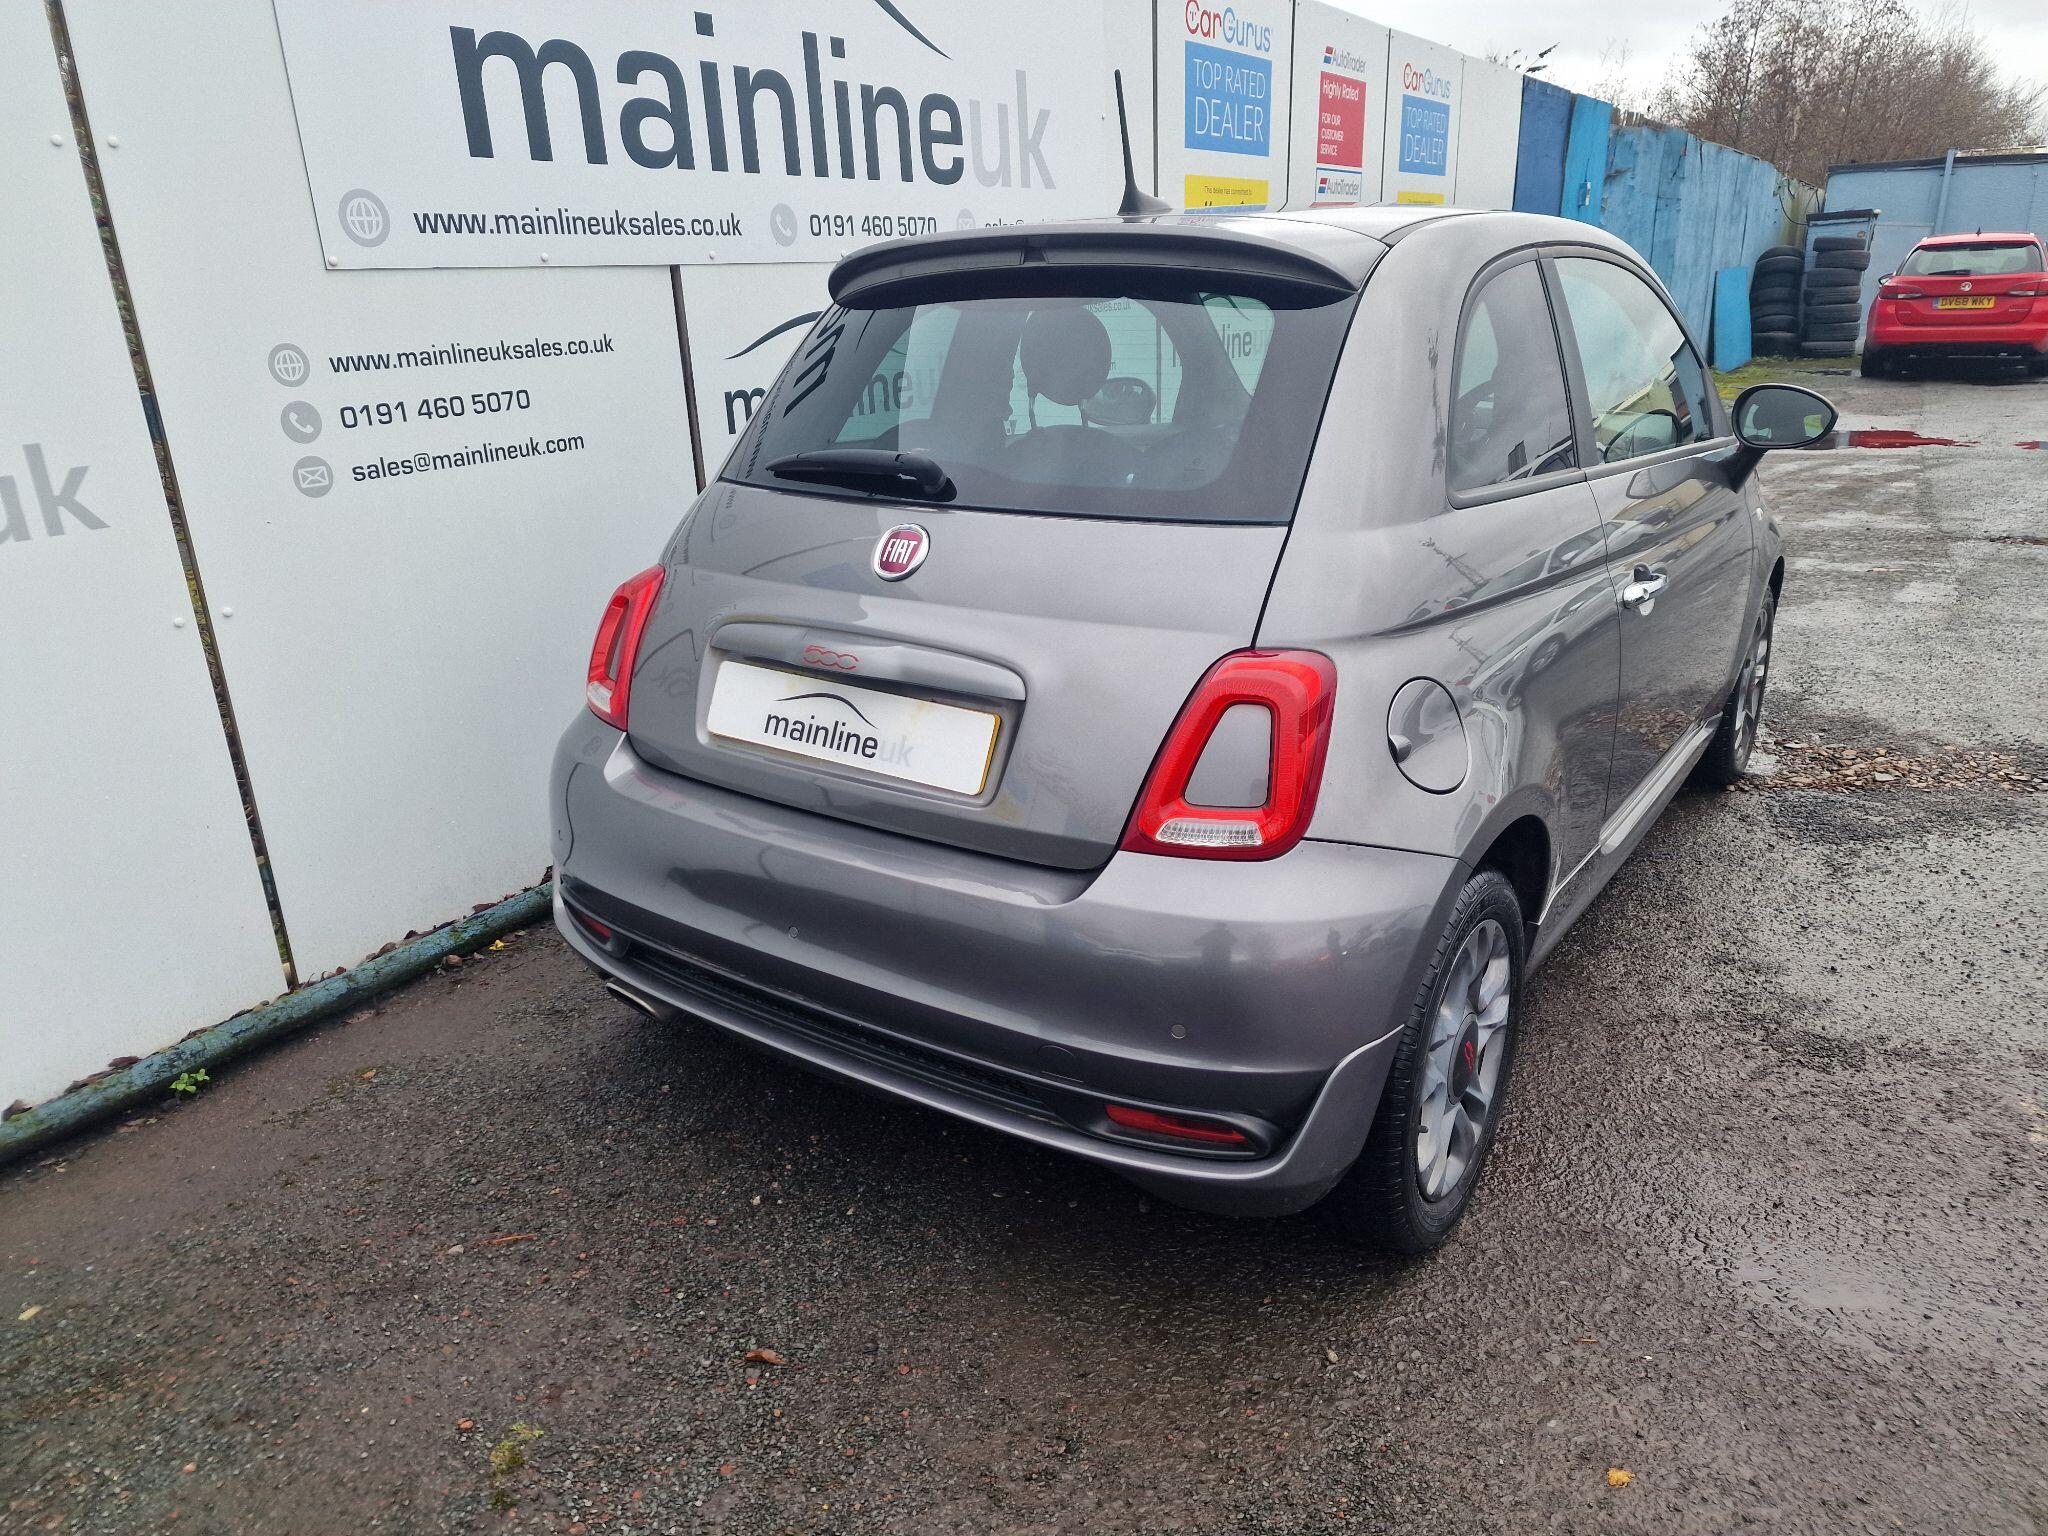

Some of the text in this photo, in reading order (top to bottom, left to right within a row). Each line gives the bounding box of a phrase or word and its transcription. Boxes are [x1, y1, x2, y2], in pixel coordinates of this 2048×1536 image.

[1186, 0, 1271, 52] CarGurus
[1194, 58, 1266, 99] TOP RATED
[1323, 79, 1359, 101] Highly Rated
[1403, 62, 1451, 99] CarGurus
[449, 10, 1057, 191] mainlineuk
[1195, 96, 1264, 142] DEALER
[1321, 112, 1342, 126] FOR OUR
[1407, 106, 1446, 134] TOP RATED
[1320, 143, 1338, 156] SERVICE
[1321, 129, 1344, 142] CUSTOMER
[1405, 134, 1444, 165] DEALER
[413, 208, 742, 238] www.mainlineuksales.co.uk
[810, 213, 937, 237] 0191 460 5070
[1971, 295, 1993, 306] WKY
[329, 333, 614, 374] www.mainlineuksales.co.uk
[340, 389, 531, 429] 0191 460 5070
[352, 432, 585, 482] sales@mainlineuk.com
[882, 537, 918, 565] FIAT
